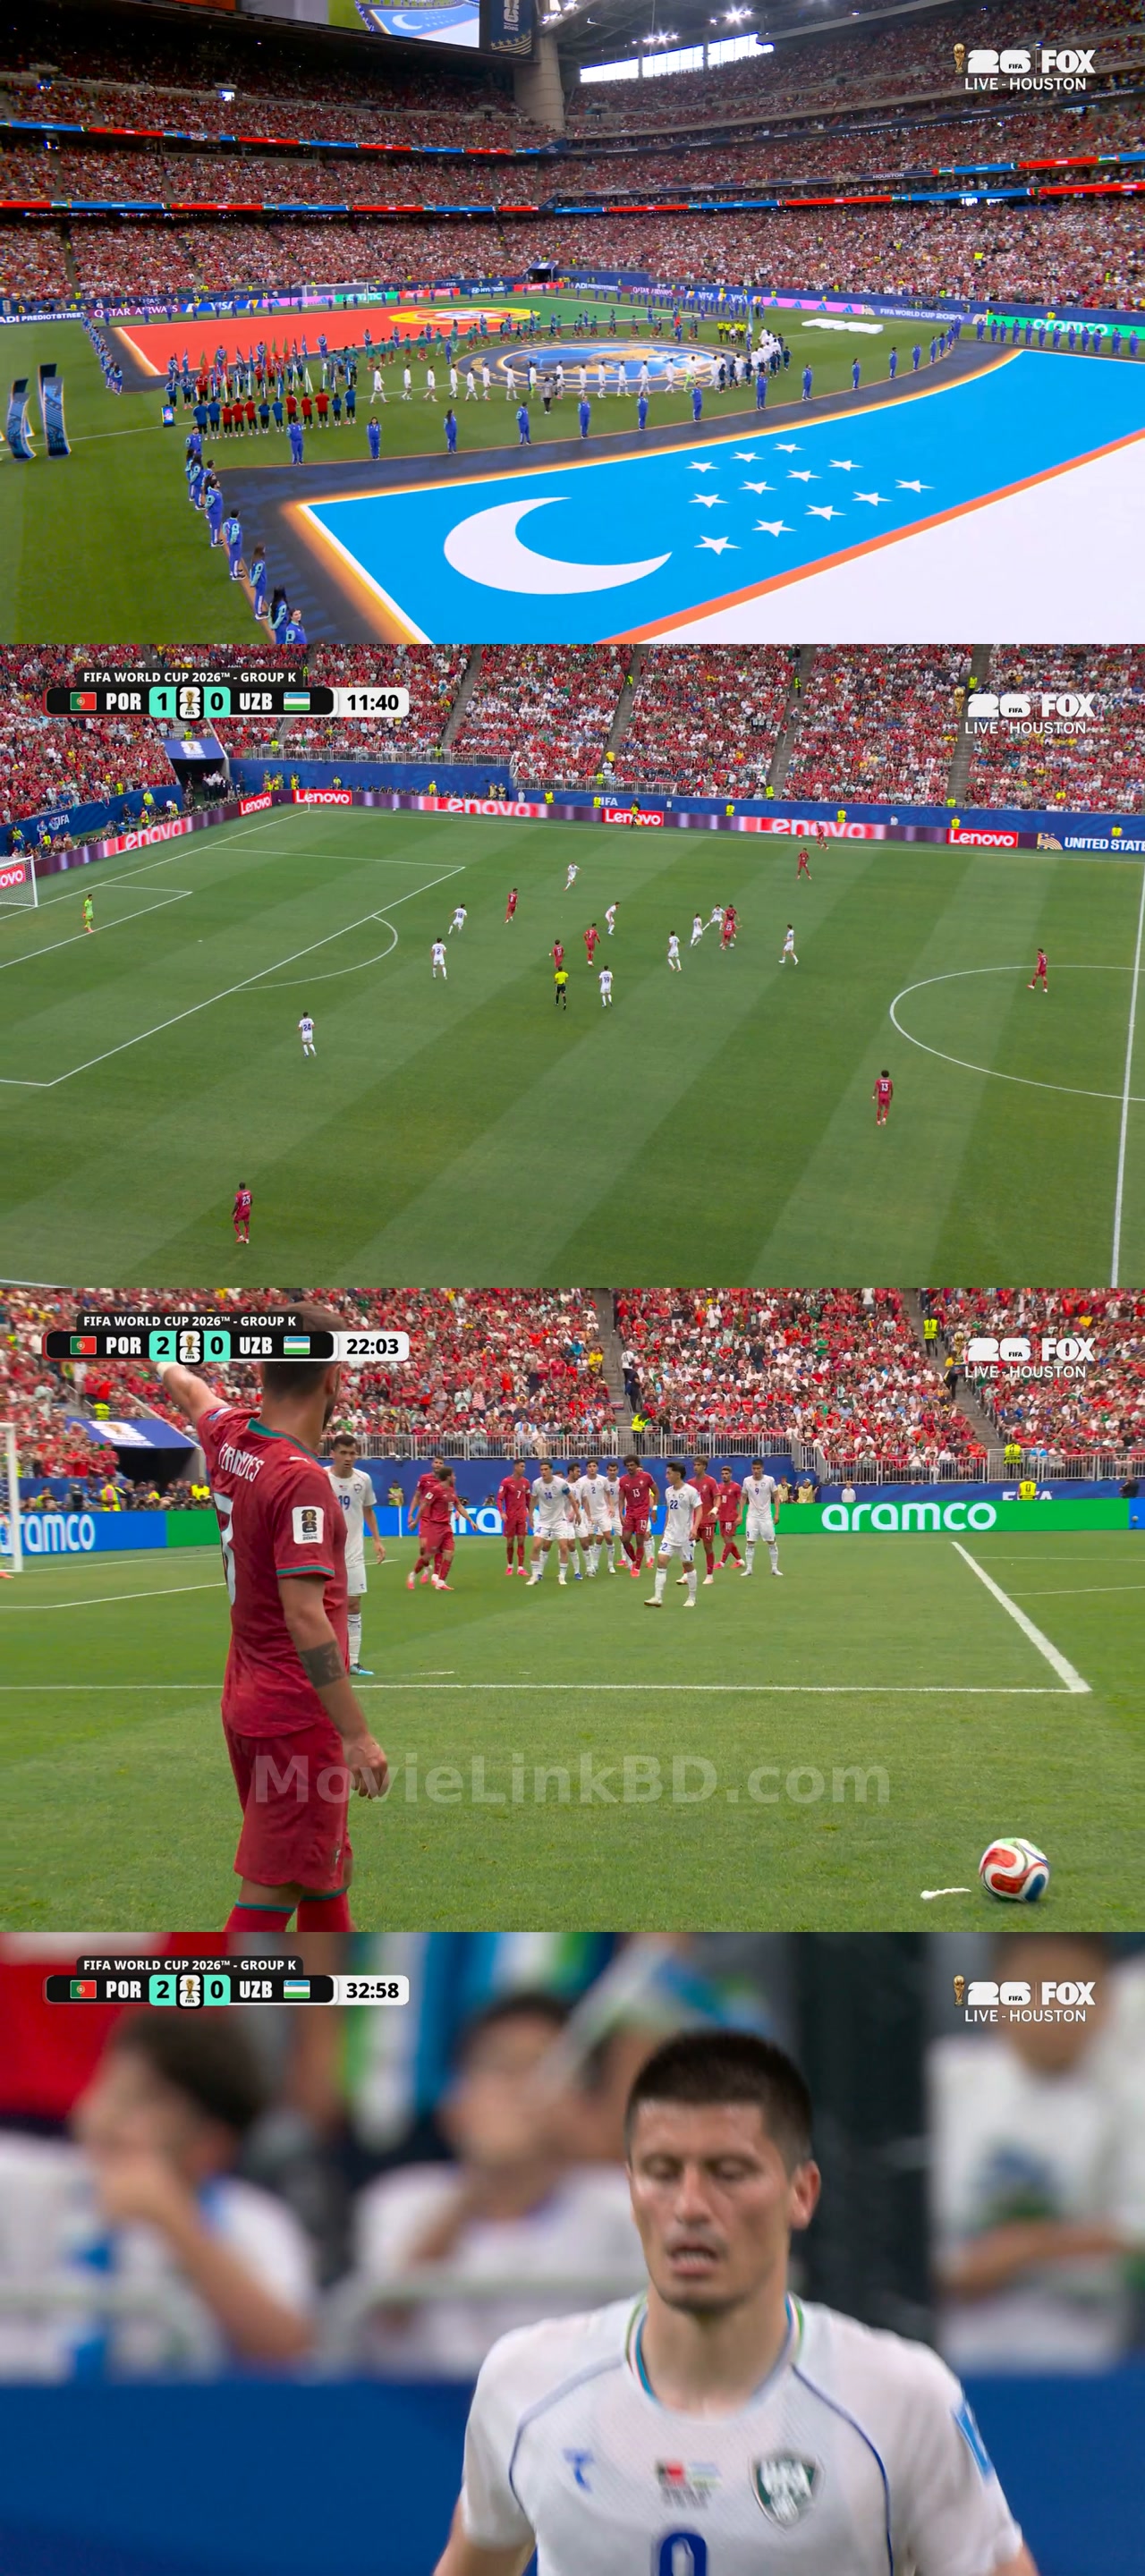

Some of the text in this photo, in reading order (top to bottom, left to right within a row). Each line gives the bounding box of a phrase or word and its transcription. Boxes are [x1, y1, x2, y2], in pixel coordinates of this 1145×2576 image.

[872, 172, 905, 180] HOUSTON
[698, 292, 715, 301] VISA
[730, 294, 749, 305] VISA
[134, 304, 179, 315] ARWAS
[880, 308, 895, 316] FIFA
[895, 309, 920, 318] WORLD
[920, 311, 936, 319] CUP
[1033, 318, 1108, 336] aramco
[295, 789, 351, 805] Lenovo
[601, 796, 619, 807] IFA
[241, 795, 272, 815] Lenovo
[949, 831, 1015, 848] Lenovo
[1064, 836, 1109, 850] UNITED
[303, 1023, 312, 1031] 24
[516, 1489, 522, 1499] 7
[544, 1491, 553, 1500] 14
[591, 1486, 597, 1495] 2
[632, 1487, 640, 1498] 13
[338, 1495, 351, 1510] 19
[669, 1499, 679, 1510] 22
[820, 1503, 997, 1532] aramco
